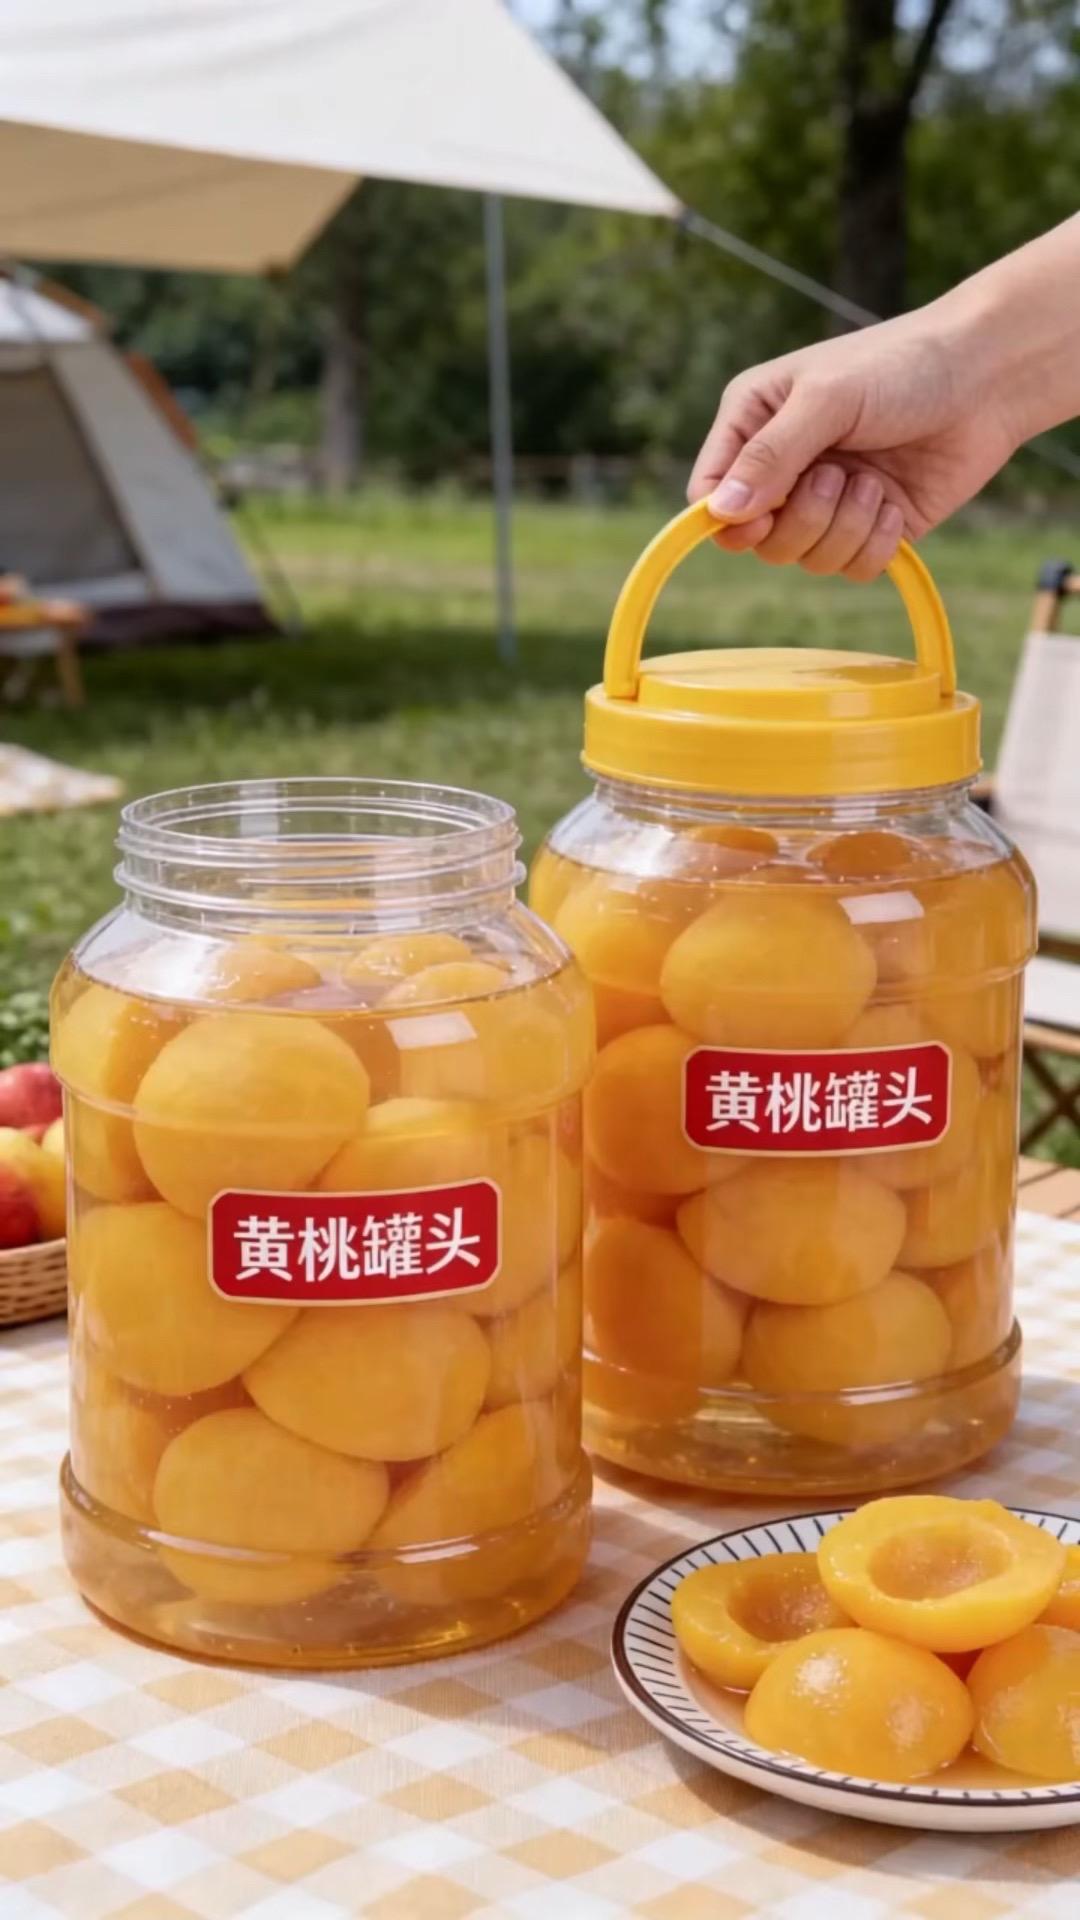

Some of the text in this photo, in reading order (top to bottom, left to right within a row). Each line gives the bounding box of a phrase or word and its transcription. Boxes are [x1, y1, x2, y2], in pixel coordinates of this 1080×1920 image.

[705, 1066, 933, 1133] 黄桃罐头
[233, 1207, 481, 1282] 黄桃罐头
